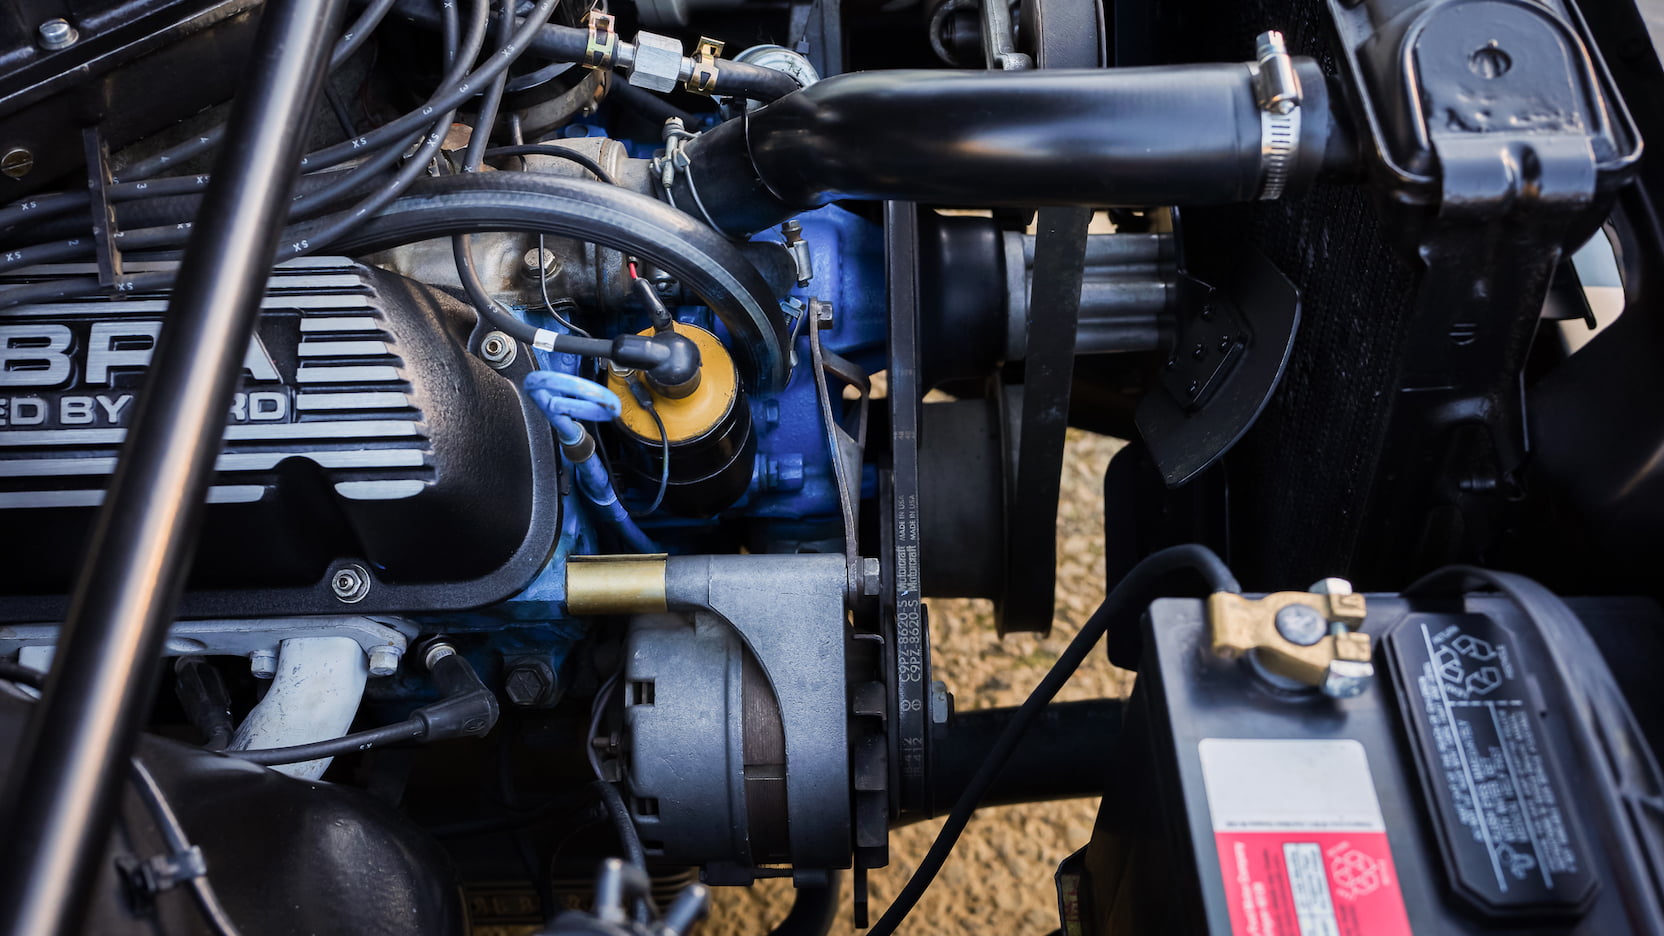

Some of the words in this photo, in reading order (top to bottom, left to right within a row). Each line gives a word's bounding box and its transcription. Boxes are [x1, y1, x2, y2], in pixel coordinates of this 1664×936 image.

[60, 394, 134, 424] BY
[898, 494, 906, 510] USA
[899, 510, 906, 520] IN
[909, 510, 917, 520] IN
[909, 520, 917, 541] MADE
[895, 545, 907, 592] Motorcraft
[906, 545, 918, 592] Motorcraft
